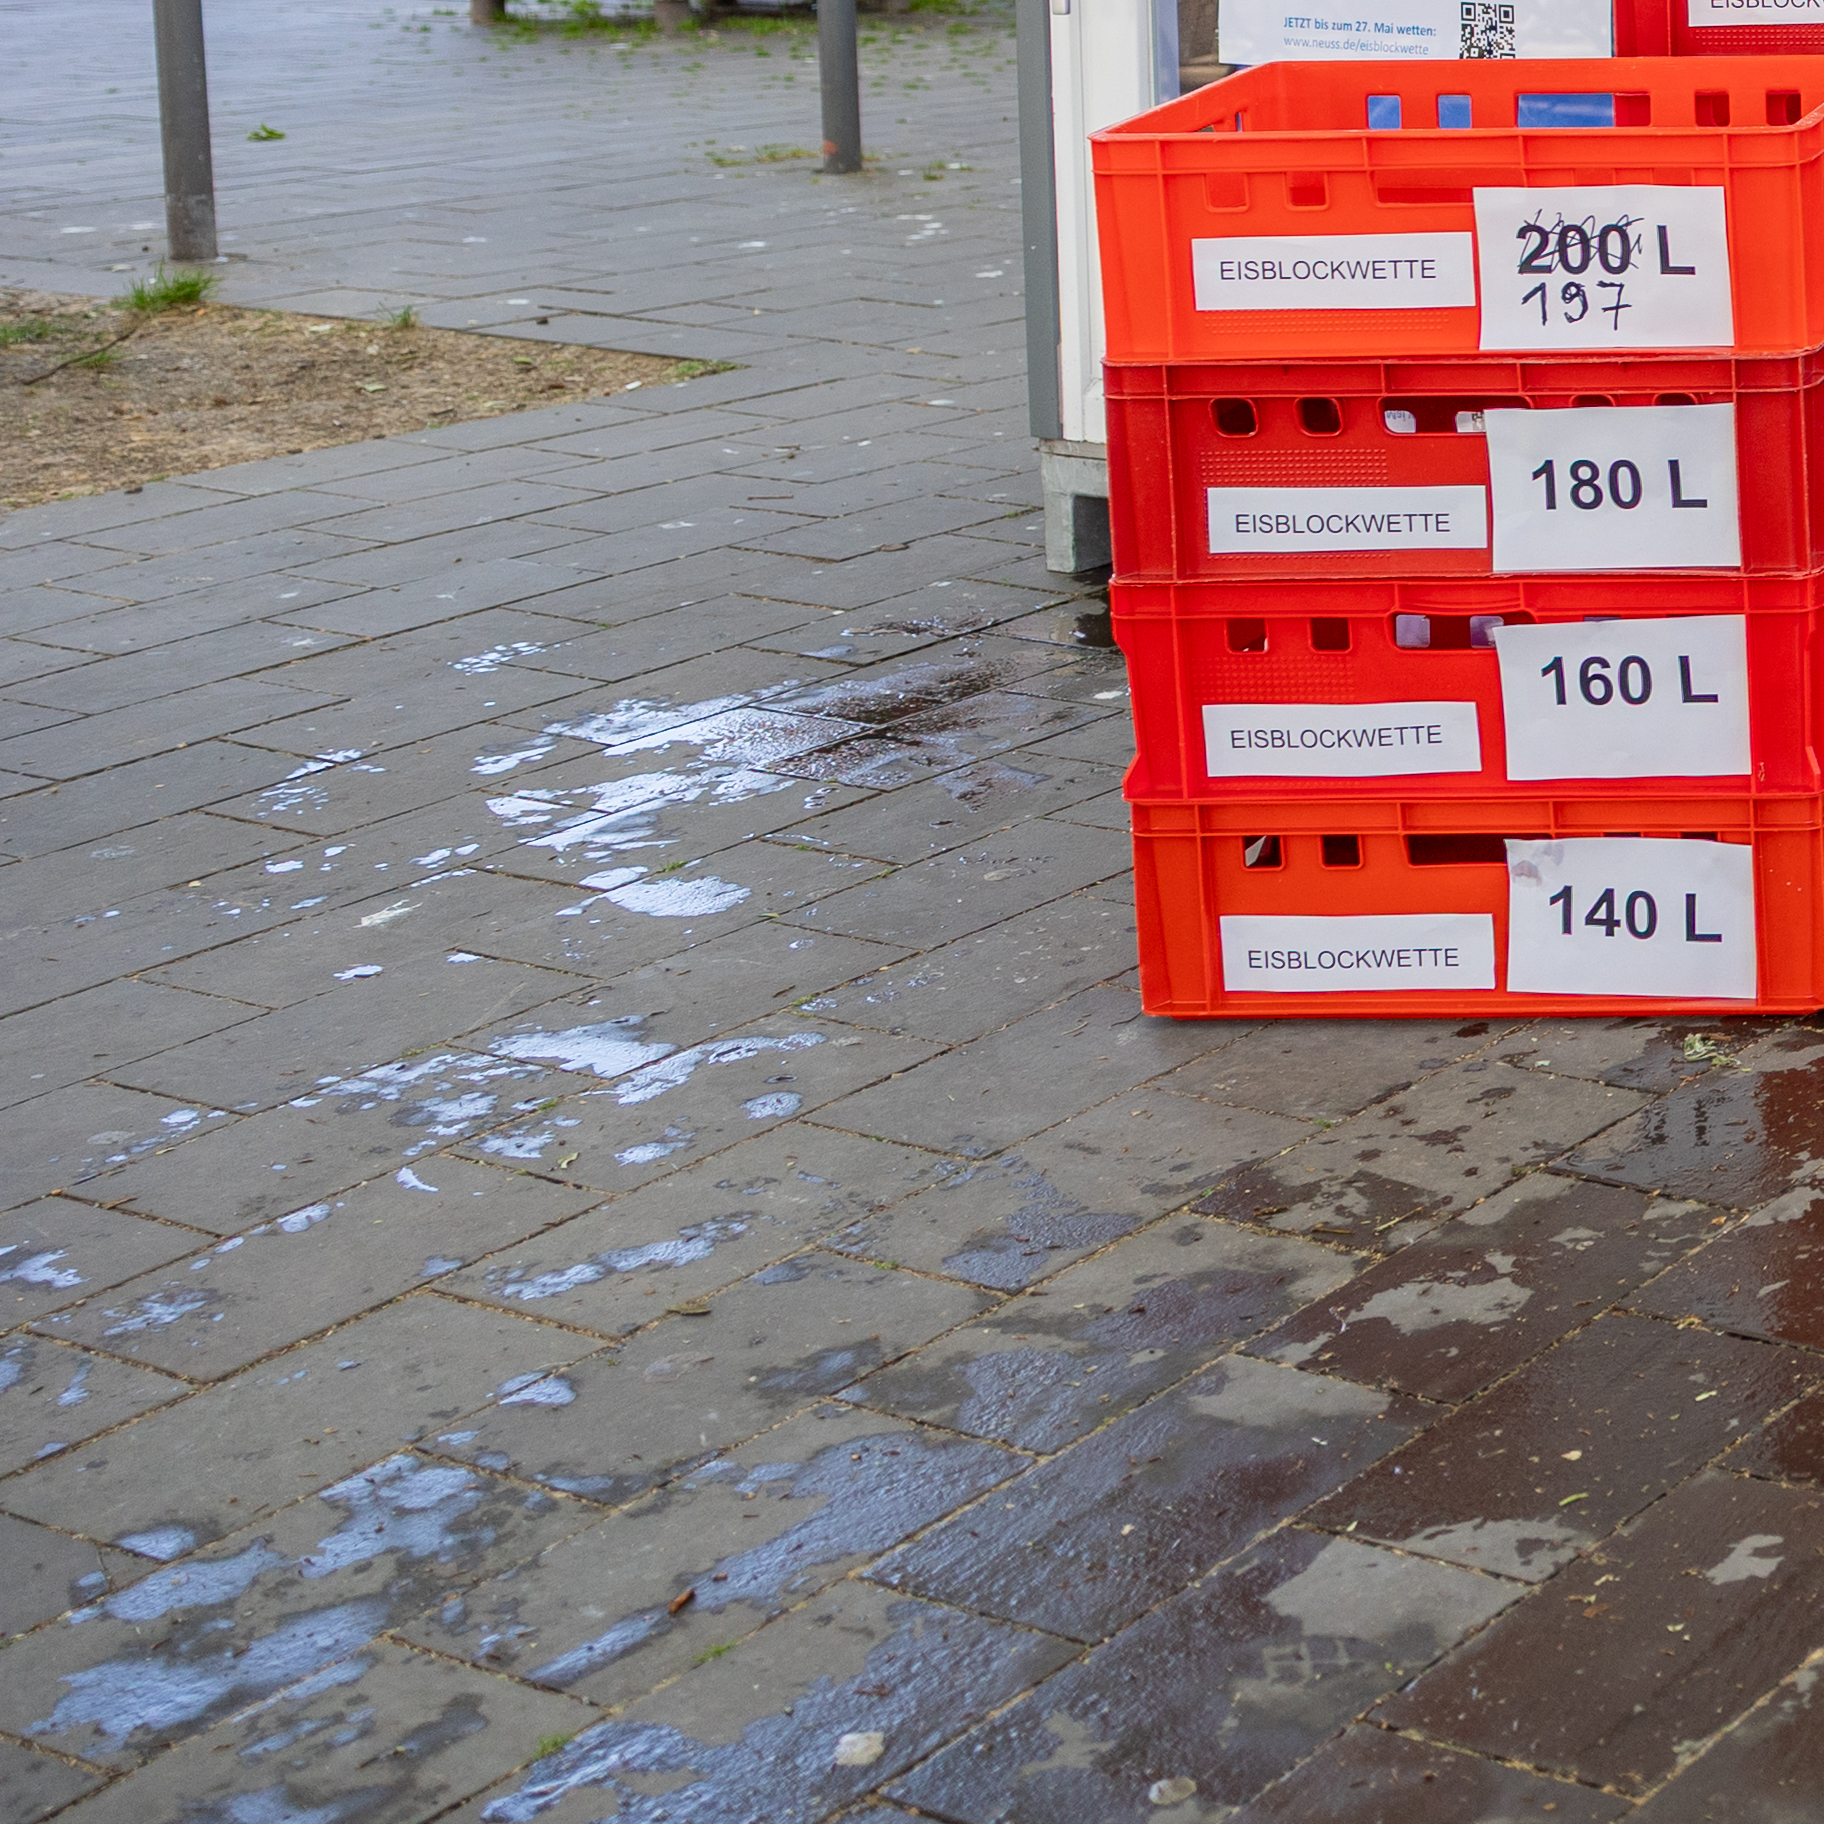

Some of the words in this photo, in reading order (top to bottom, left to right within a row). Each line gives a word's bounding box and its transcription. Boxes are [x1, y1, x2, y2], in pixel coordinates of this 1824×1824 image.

[1283, 16, 1313, 29] JETZT
[1314, 18, 1329, 30] bis
[1331, 21, 1353, 32] zum
[1354, 20, 1371, 33] 27.
[1373, 22, 1394, 34] Mai
[1395, 25, 1437, 37] wetten:
[1517, 224, 1632, 275] 200
[1658, 226, 1695, 274] L
[1221, 260, 1435, 279] EISBLOCKWETTE
[1522, 281, 1631, 330] 197
[1533, 460, 1640, 509] 180
[1669, 460, 1707, 508] L
[1237, 514, 1449, 533] EISBLOCKWETTE
[1542, 657, 1651, 705] 160
[1679, 656, 1718, 703] L
[1231, 725, 1441, 748] EISBLOCKWETTE
[1550, 886, 1656, 938] 140
[1686, 894, 1722, 942] L
[1249, 949, 1458, 968] EISBLOCKWETTE
